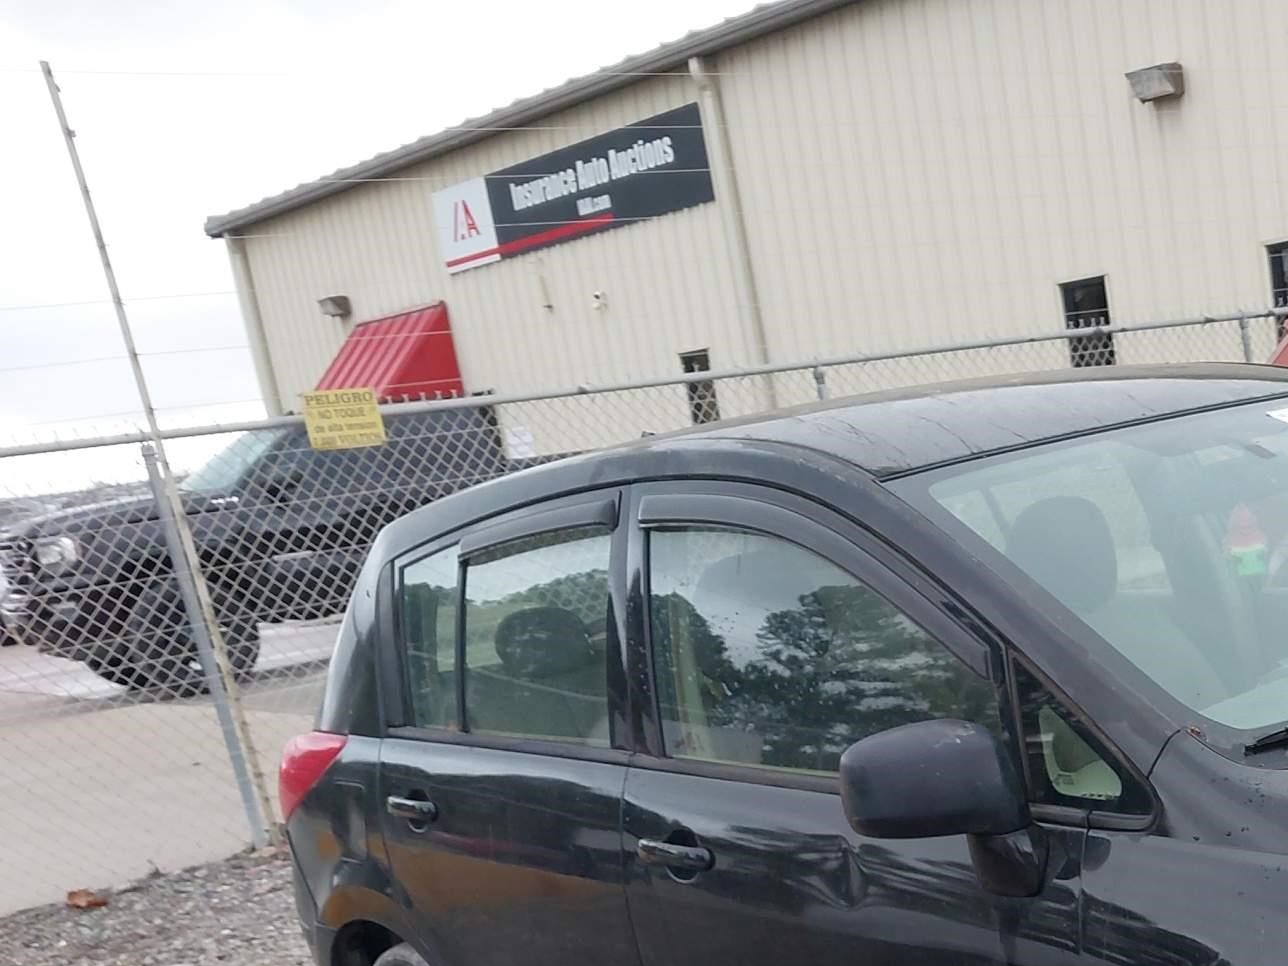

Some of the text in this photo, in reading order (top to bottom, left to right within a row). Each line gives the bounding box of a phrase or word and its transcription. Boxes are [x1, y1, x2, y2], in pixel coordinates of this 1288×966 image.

[509, 168, 578, 212] Insurance
[575, 157, 610, 191] Auto
[608, 136, 675, 180] Auctions
[304, 391, 373, 406] PELIGRO
[317, 406, 367, 419] NO TOQUE
